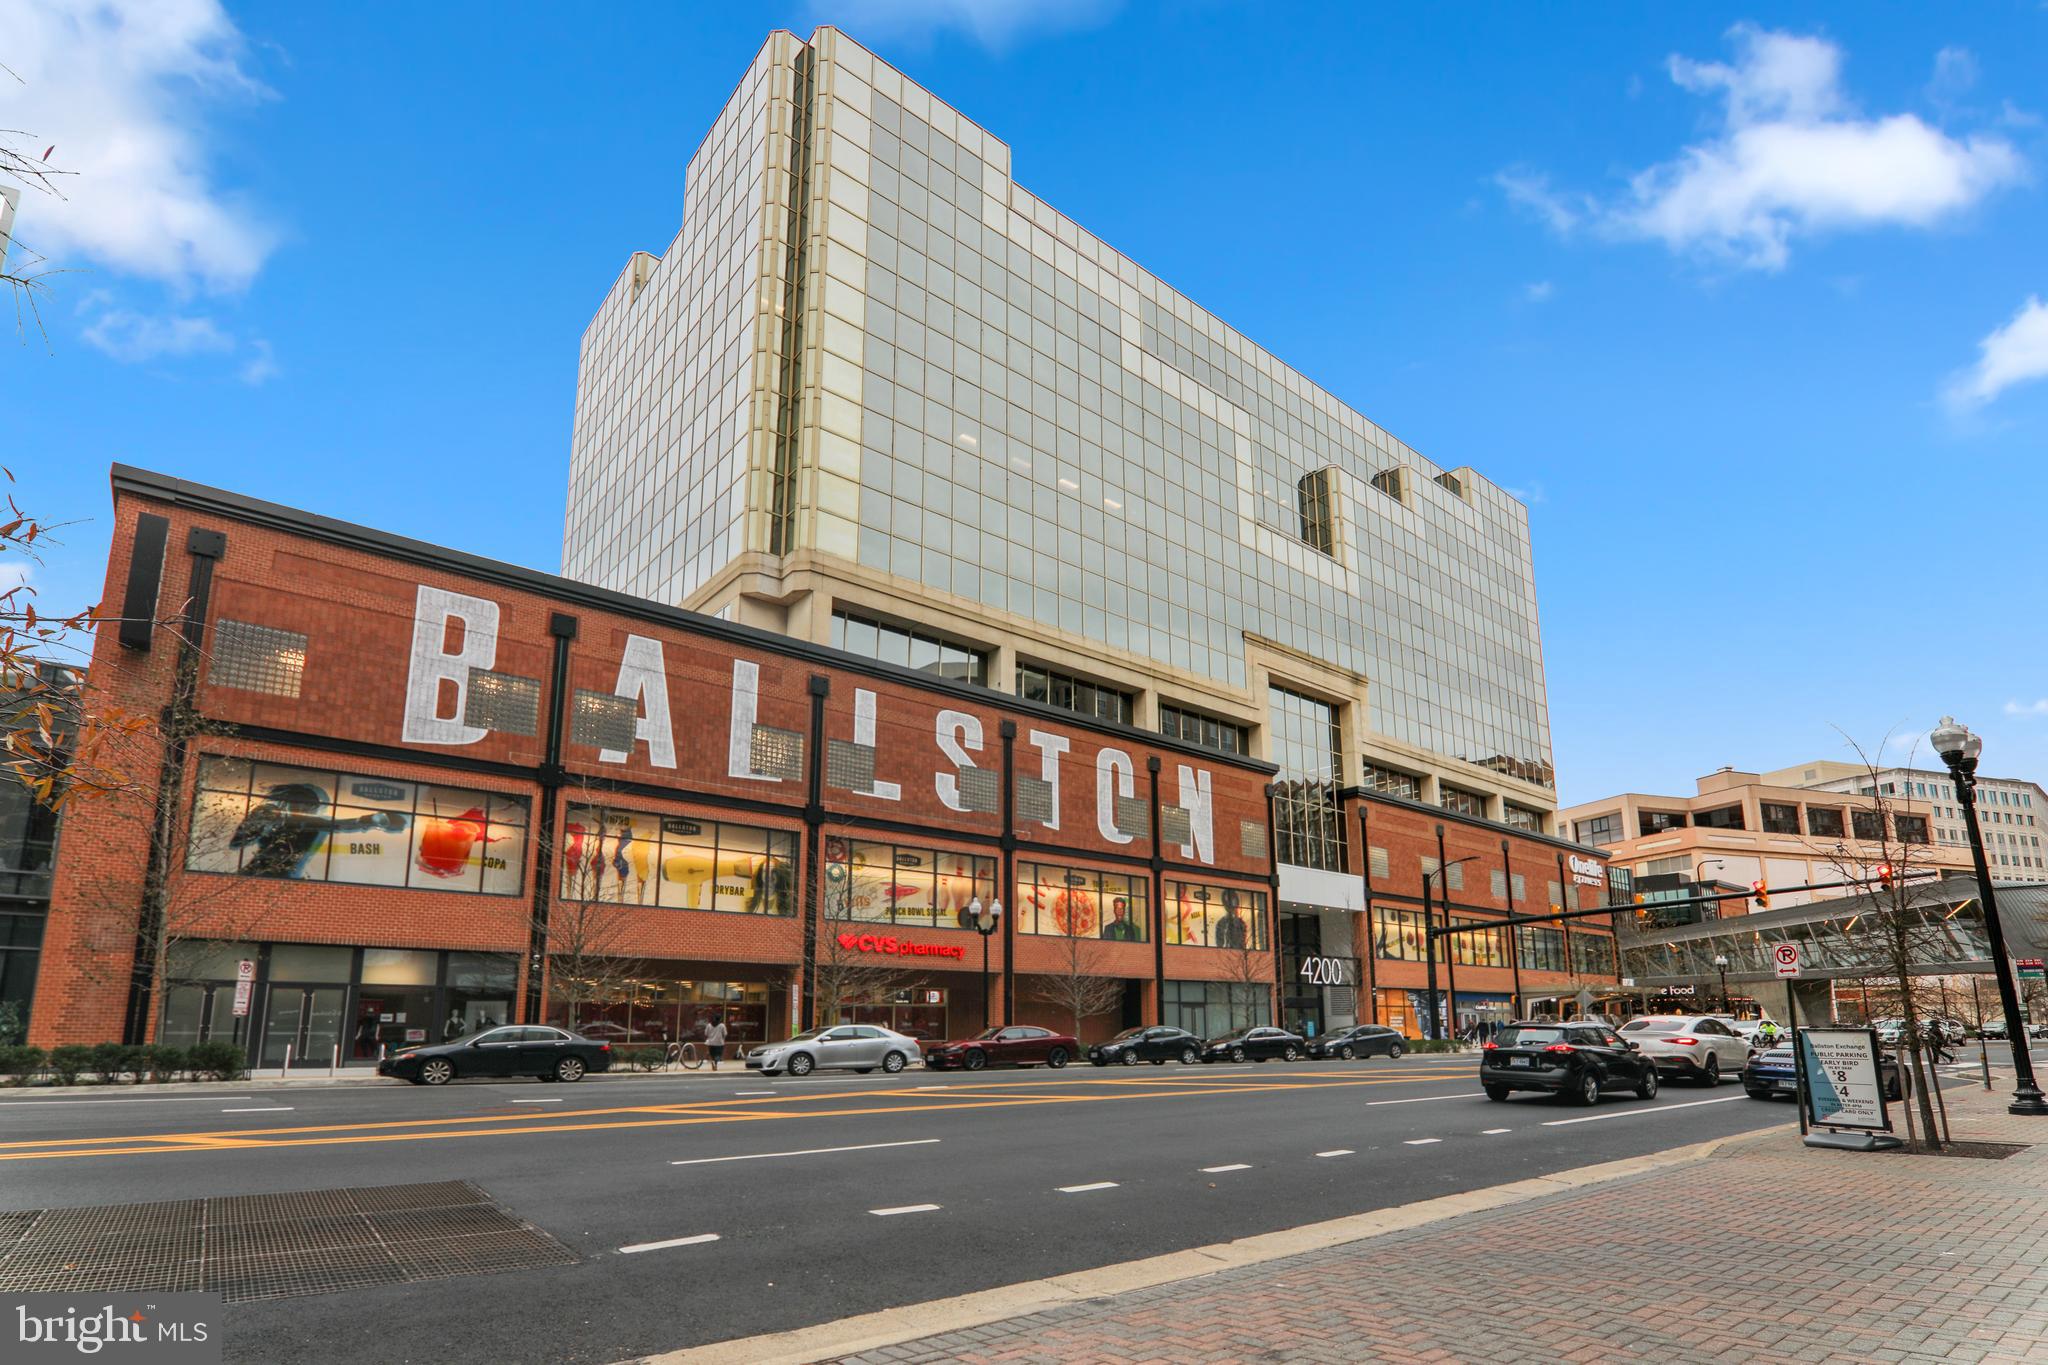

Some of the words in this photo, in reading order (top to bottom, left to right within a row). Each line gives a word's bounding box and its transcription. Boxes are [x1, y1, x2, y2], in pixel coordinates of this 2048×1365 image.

[350, 843, 380, 855] BASH
[483, 856, 506, 870] COPA
[1569, 855, 1602, 877] Onelife
[714, 884, 745, 897] DRYBAR
[908, 908, 926, 917] BOWL
[927, 909, 947, 917] SOIAL
[858, 933, 898, 954] CVS
[900, 941, 966, 960] pharmacy
[1300, 957, 1341, 985] 4200
[1670, 985, 1695, 995] Food
[1832, 1070, 1847, 1082] $8
